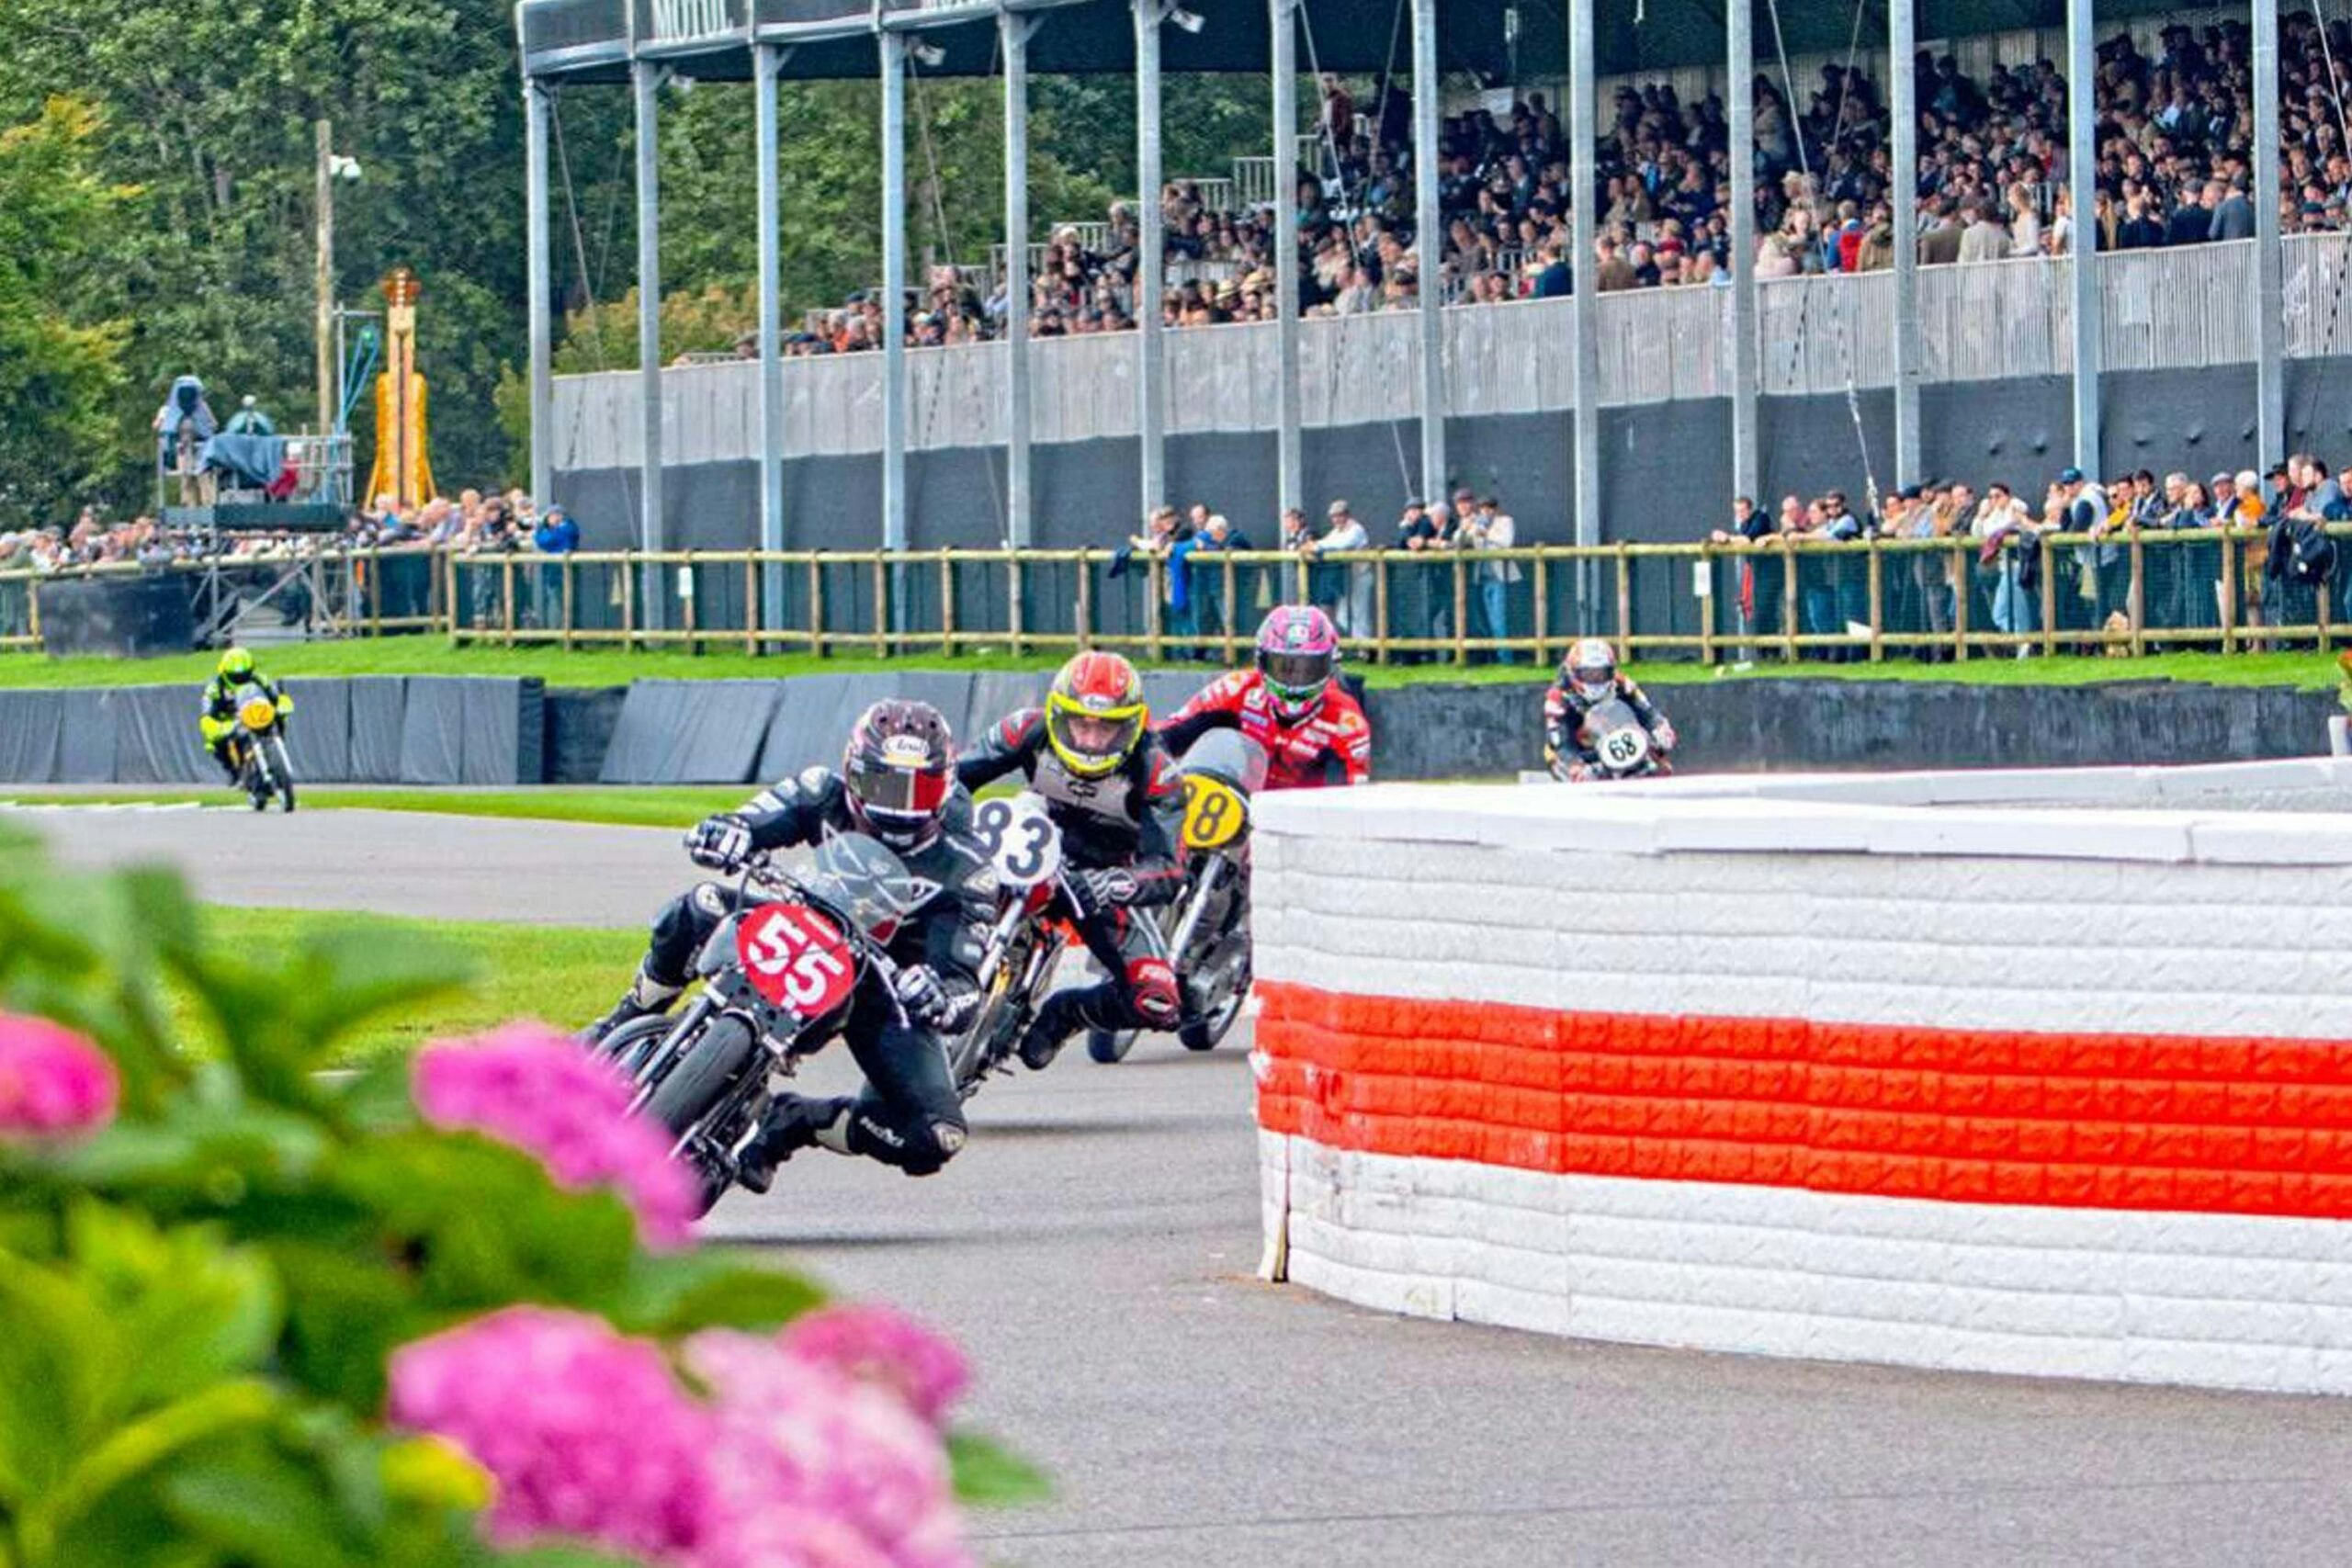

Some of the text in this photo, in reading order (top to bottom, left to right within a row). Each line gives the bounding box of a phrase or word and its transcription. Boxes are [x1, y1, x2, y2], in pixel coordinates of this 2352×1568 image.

[1609, 732, 1637, 761] 68
[976, 800, 1052, 878] 83
[748, 910, 845, 1006] 55
